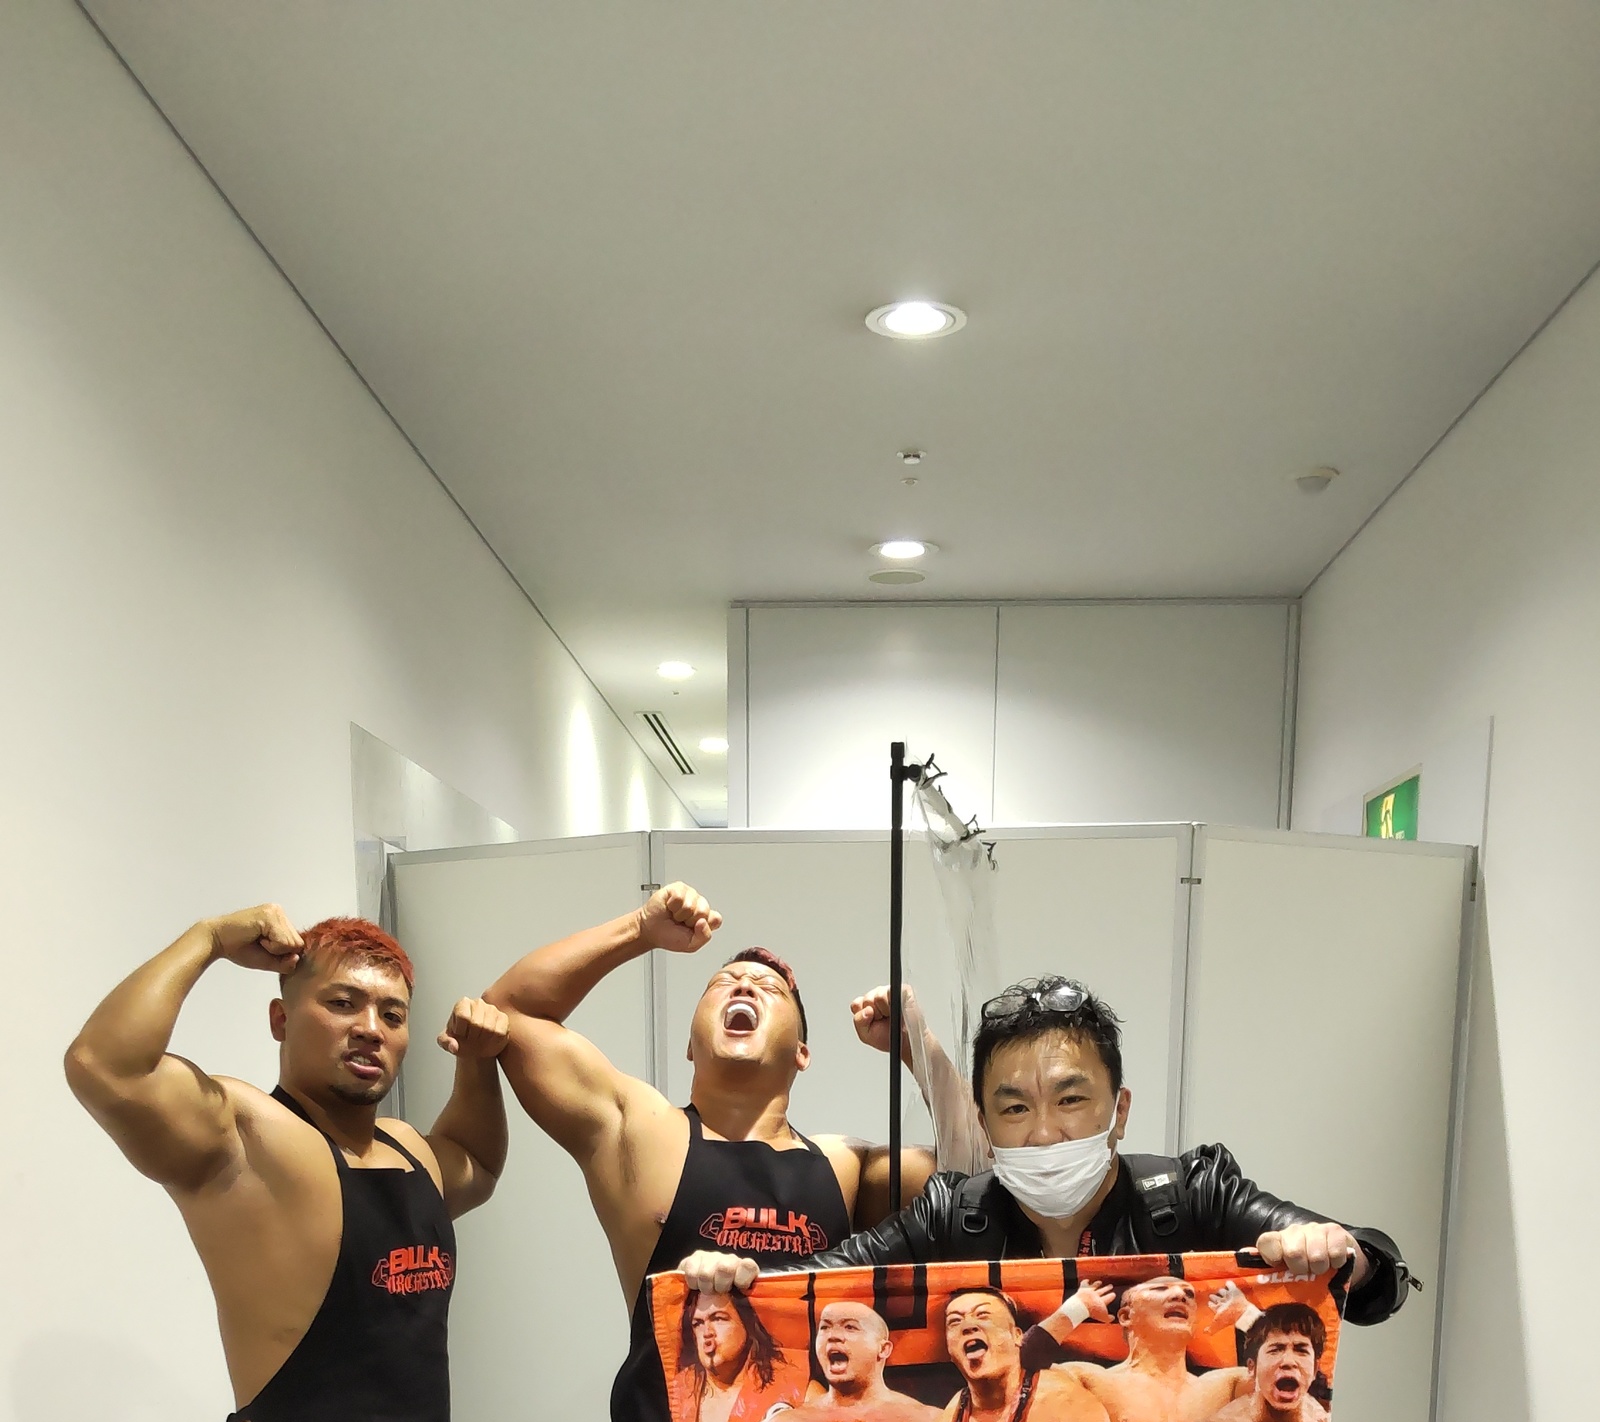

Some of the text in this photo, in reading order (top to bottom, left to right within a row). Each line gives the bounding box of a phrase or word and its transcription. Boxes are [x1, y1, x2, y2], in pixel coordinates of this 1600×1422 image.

[723, 1207, 810, 1237] BULK
[717, 1229, 814, 1256] ORCHESTRA
[389, 1245, 445, 1275] BULK
